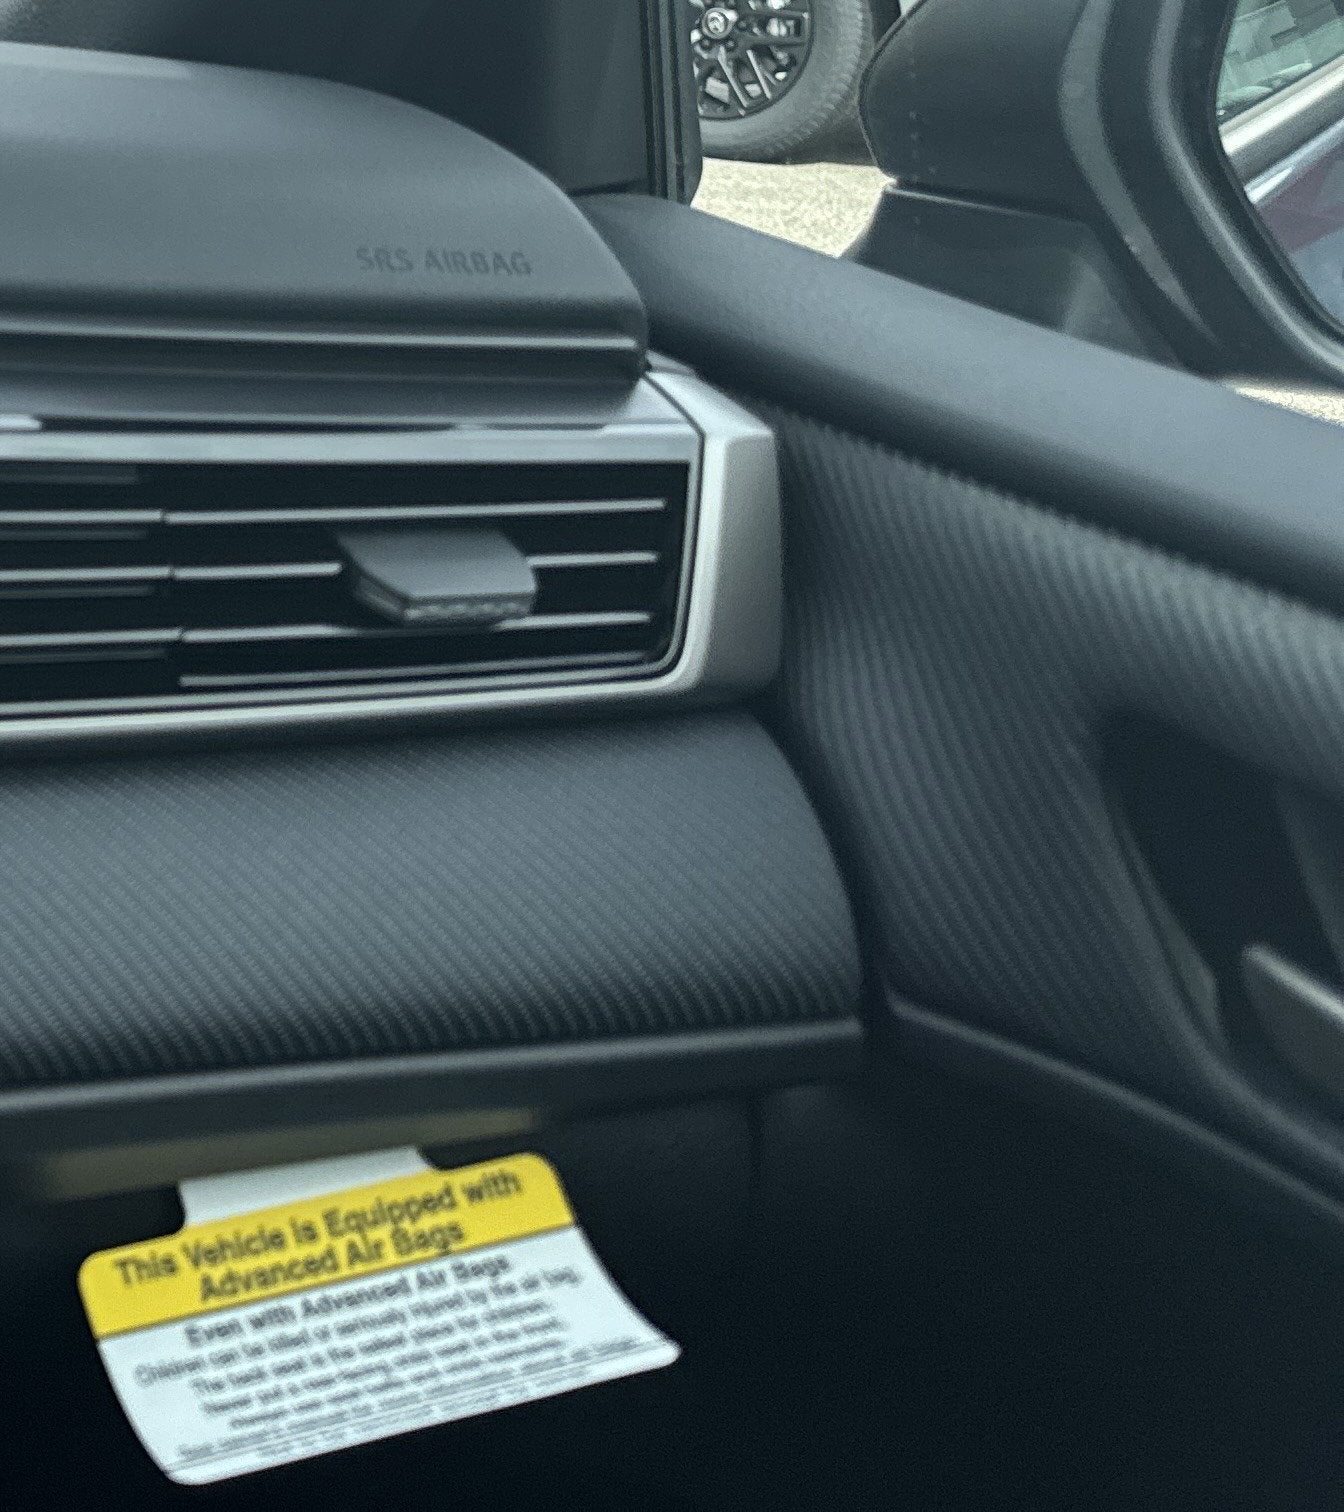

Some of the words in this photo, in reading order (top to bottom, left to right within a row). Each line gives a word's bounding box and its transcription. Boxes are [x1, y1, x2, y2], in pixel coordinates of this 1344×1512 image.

[356, 246, 413, 274] SRS
[424, 249, 533, 276] AIRBAG
[114, 1252, 180, 1287] This
[182, 1225, 286, 1269] Vehicle
[321, 1187, 459, 1237] Equipped
[461, 1168, 524, 1203] with
[199, 1244, 340, 1303] Advanced
[346, 1231, 384, 1268] Air
[390, 1219, 466, 1258] Bags
[184, 1319, 243, 1349] Even
[247, 1304, 297, 1331] with
[300, 1275, 410, 1319] Advanced
[415, 1268, 447, 1290] Air
[451, 1254, 510, 1281] Bags
